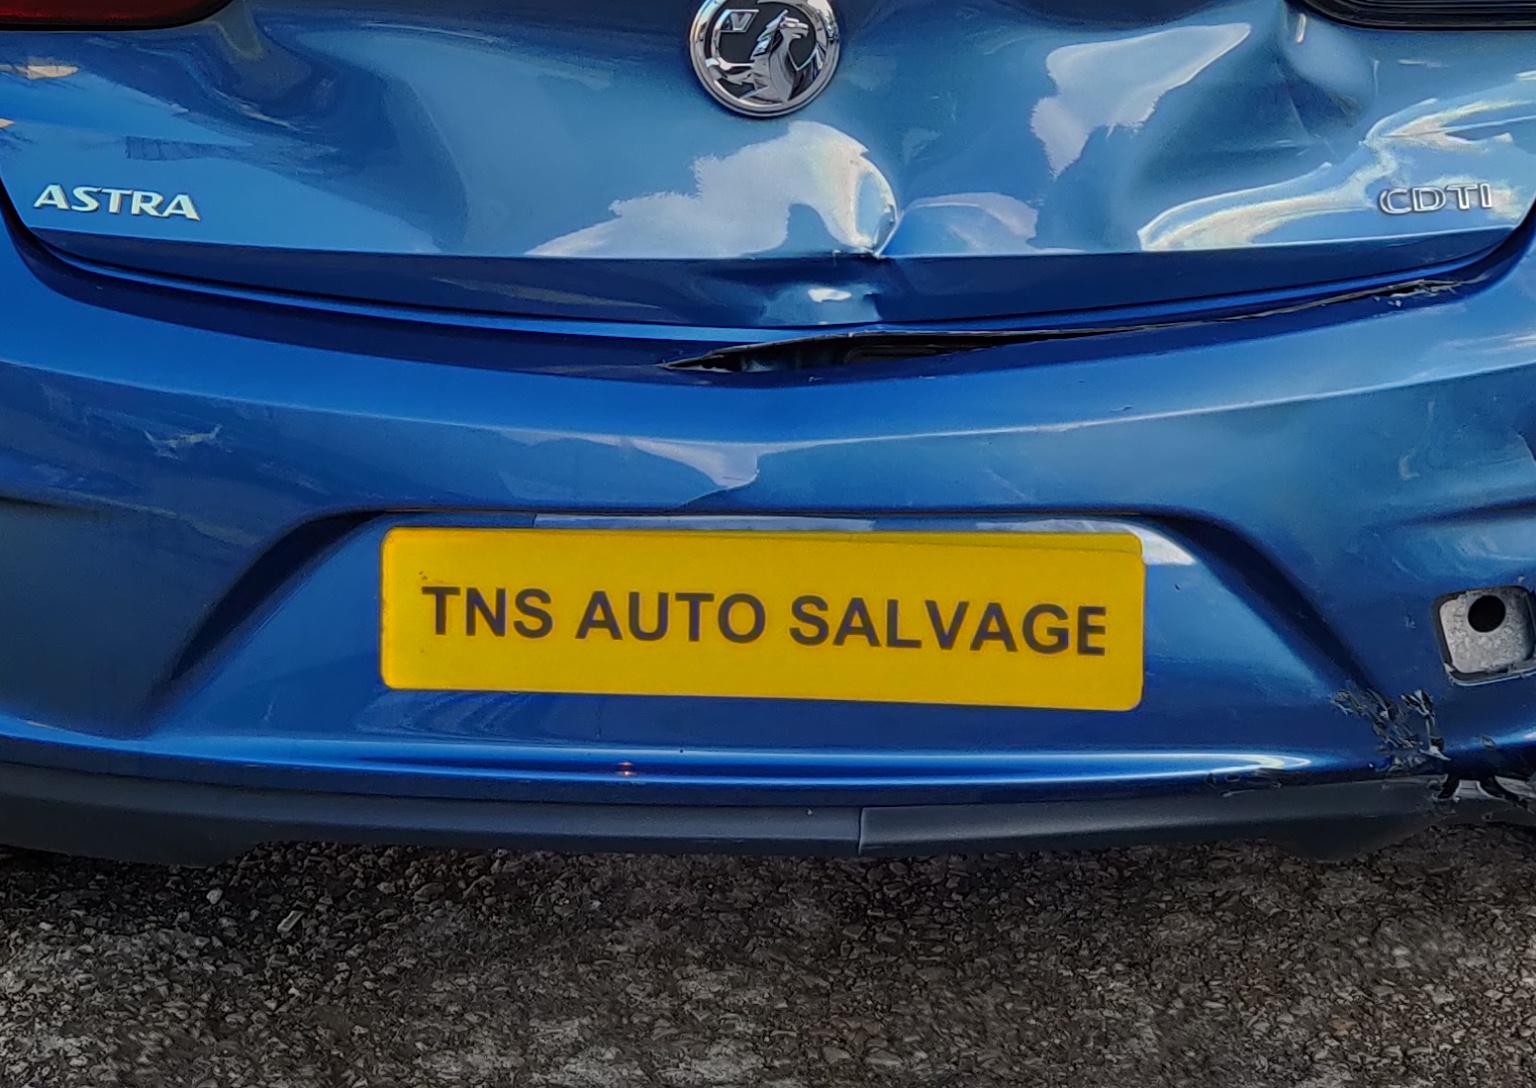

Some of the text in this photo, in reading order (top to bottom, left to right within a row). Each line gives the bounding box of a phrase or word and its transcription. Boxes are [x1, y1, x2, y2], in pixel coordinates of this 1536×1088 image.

[33, 183, 202, 222] ASTRA
[1378, 182, 1493, 215] CDTI
[421, 585, 1107, 657] TNS AUTO SALVAGE
